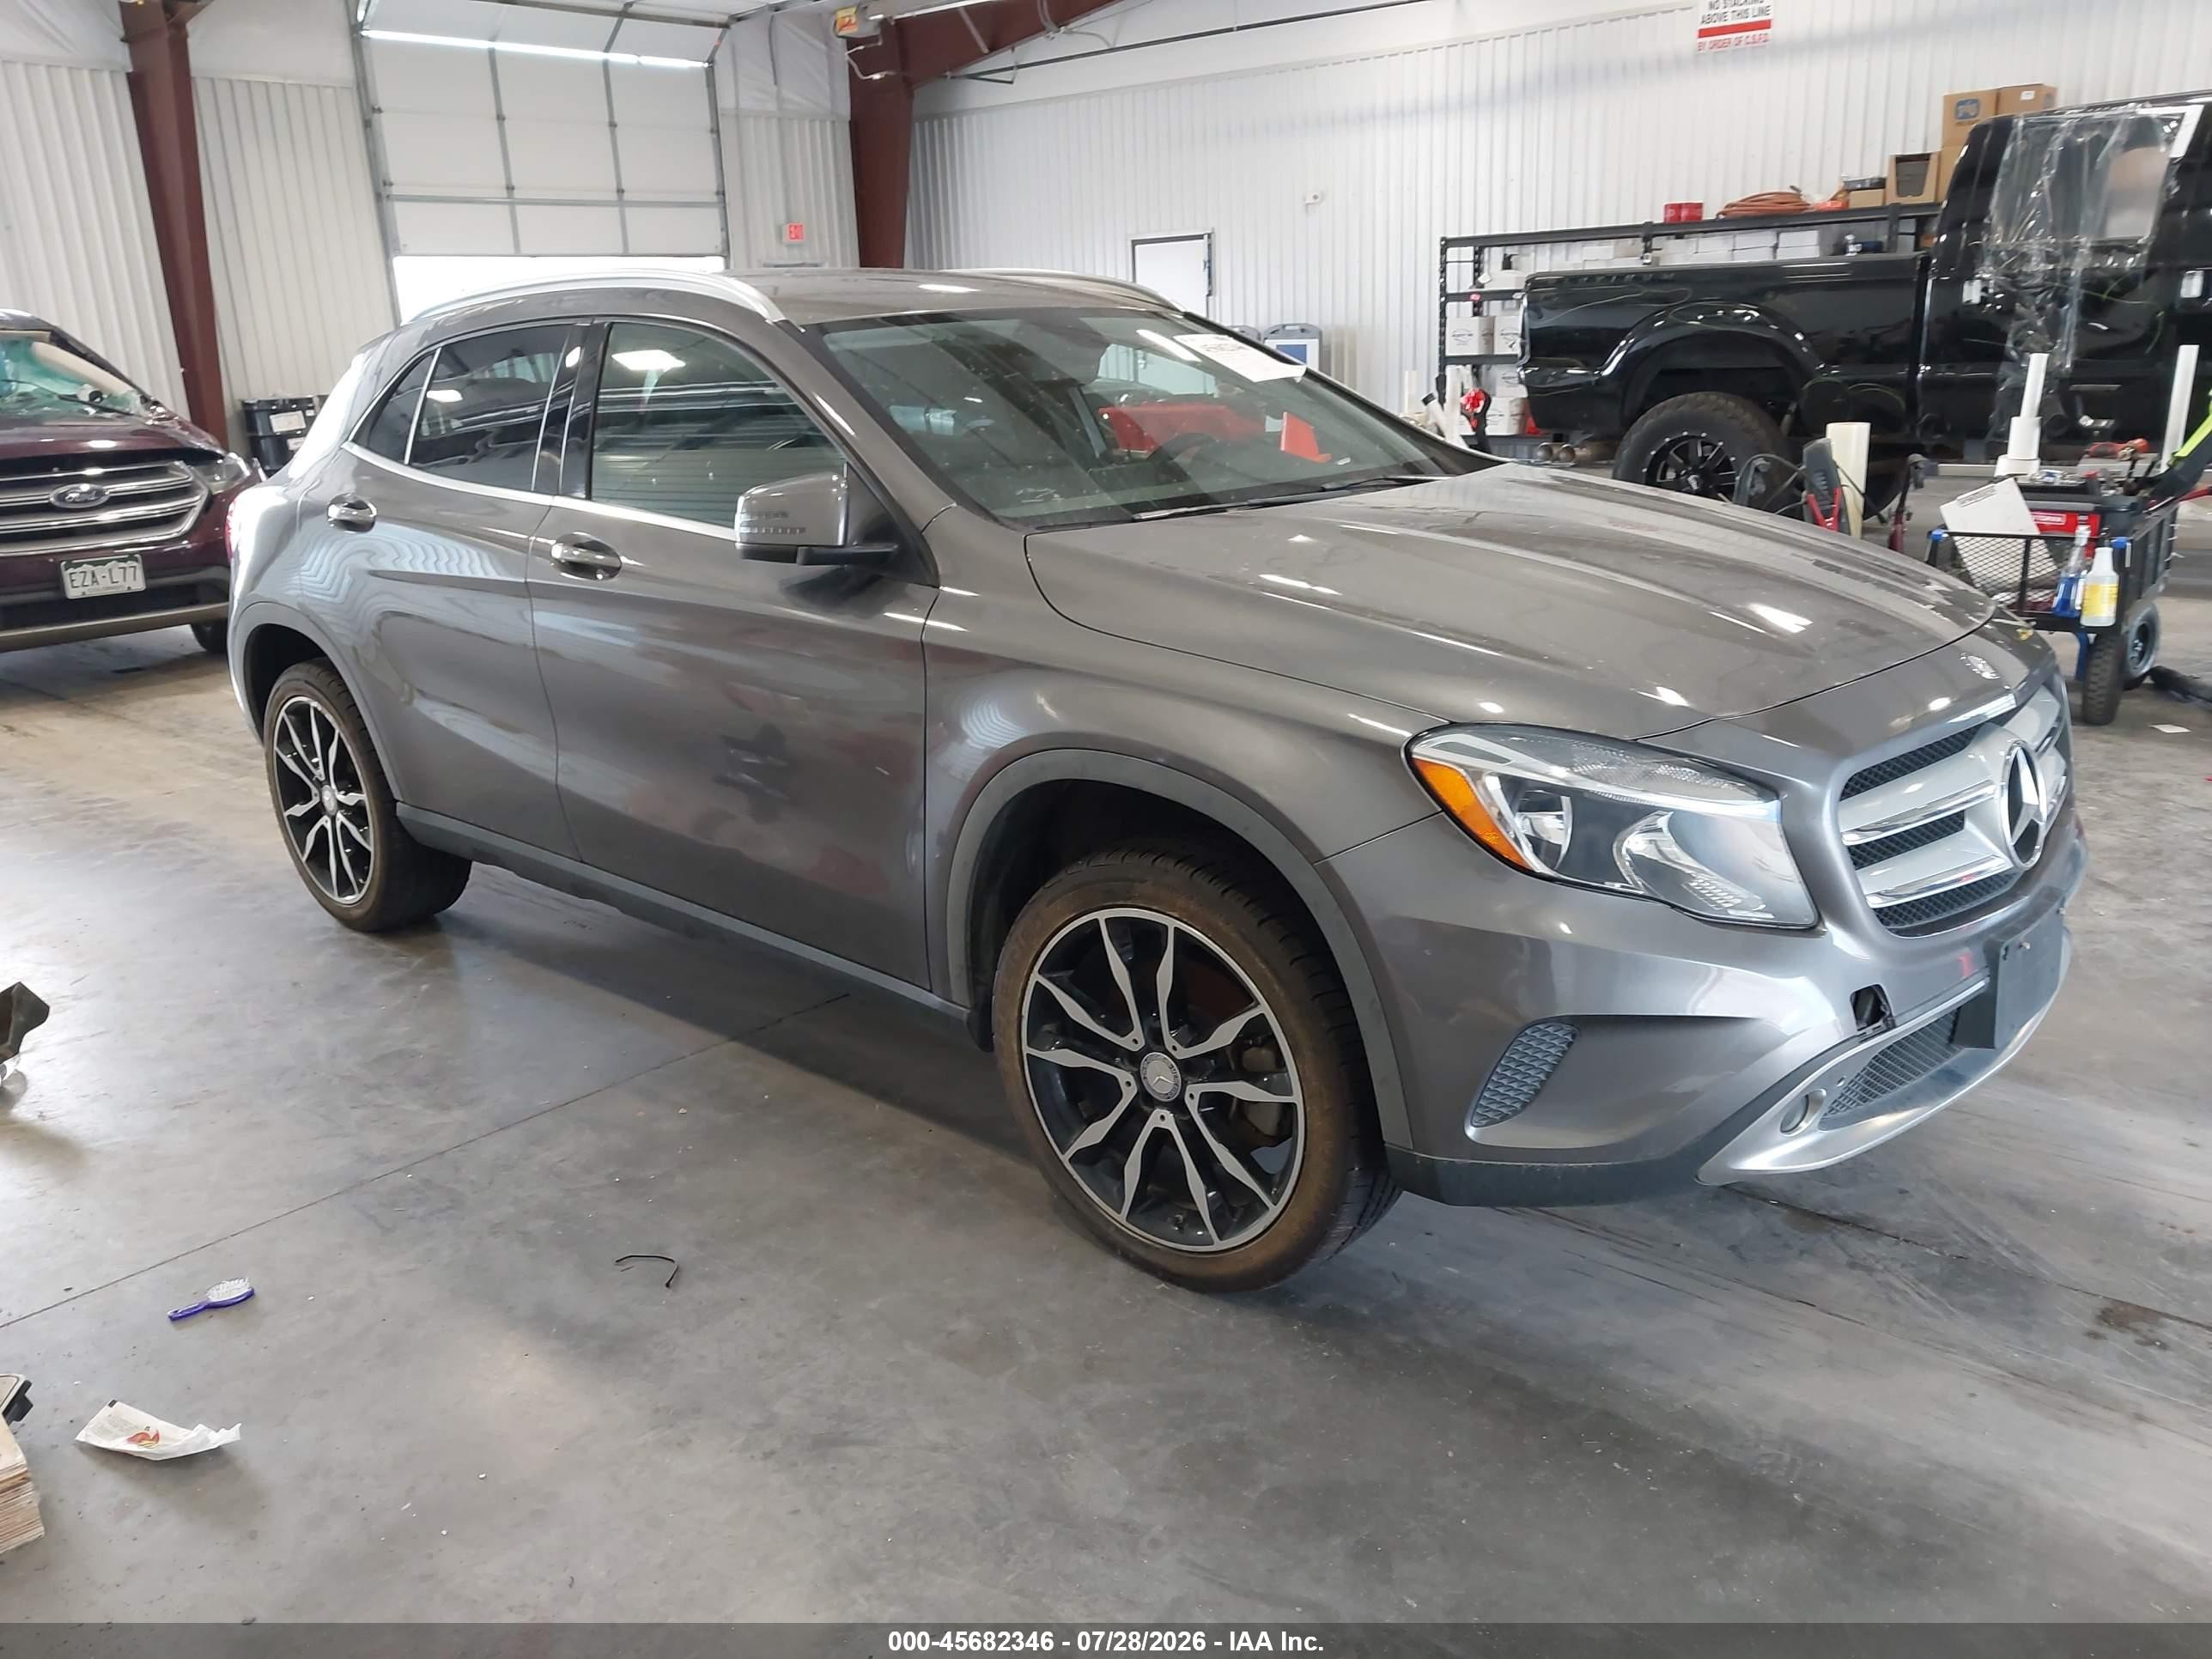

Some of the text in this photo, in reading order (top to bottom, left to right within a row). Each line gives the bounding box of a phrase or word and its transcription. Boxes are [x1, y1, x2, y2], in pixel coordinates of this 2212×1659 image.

[1701, 5, 1771, 24] ABOVE THIS LINE
[1709, 37, 1732, 50] ORDER
[1735, 35, 1744, 46] OF
[64, 489, 99, 502] Ford
